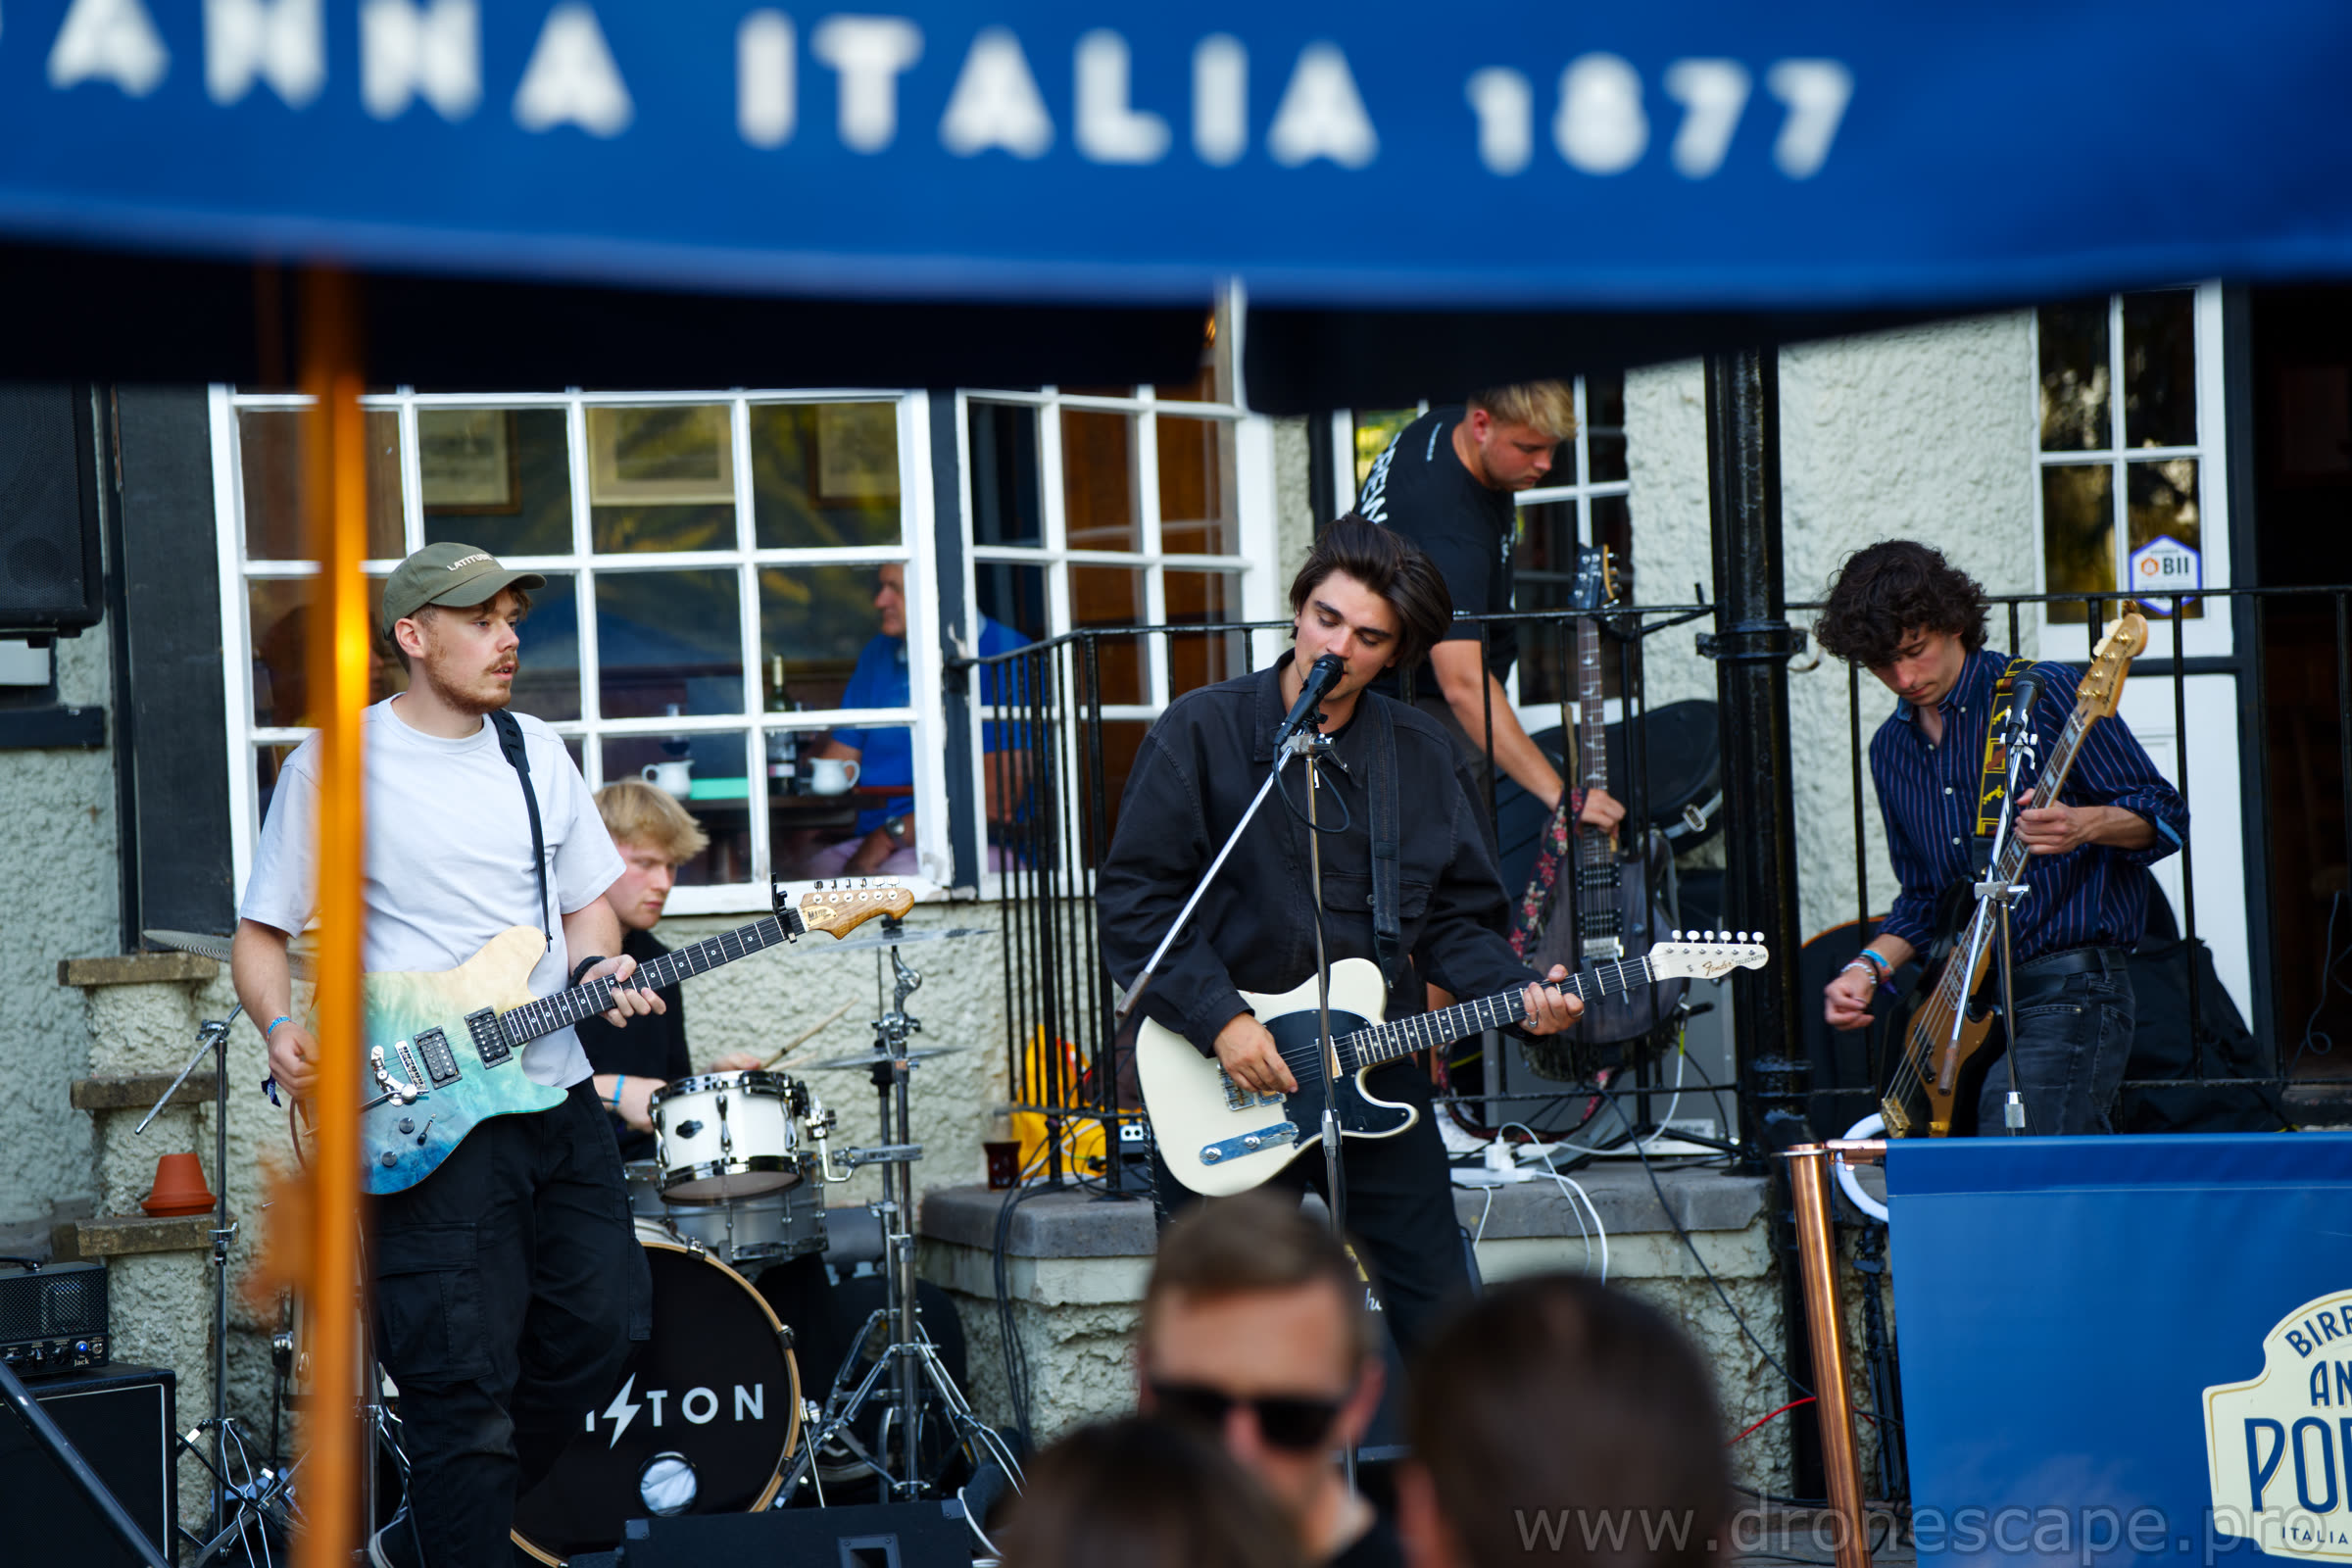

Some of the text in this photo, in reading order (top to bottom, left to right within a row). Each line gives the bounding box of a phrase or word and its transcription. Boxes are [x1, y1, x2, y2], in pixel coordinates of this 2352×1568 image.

[735, 8, 1378, 168] ITALIA
[1468, 55, 1854, 176] 1877
[2163, 557, 2189, 575] BII
[2281, 1525, 2350, 1545] ITALIA
